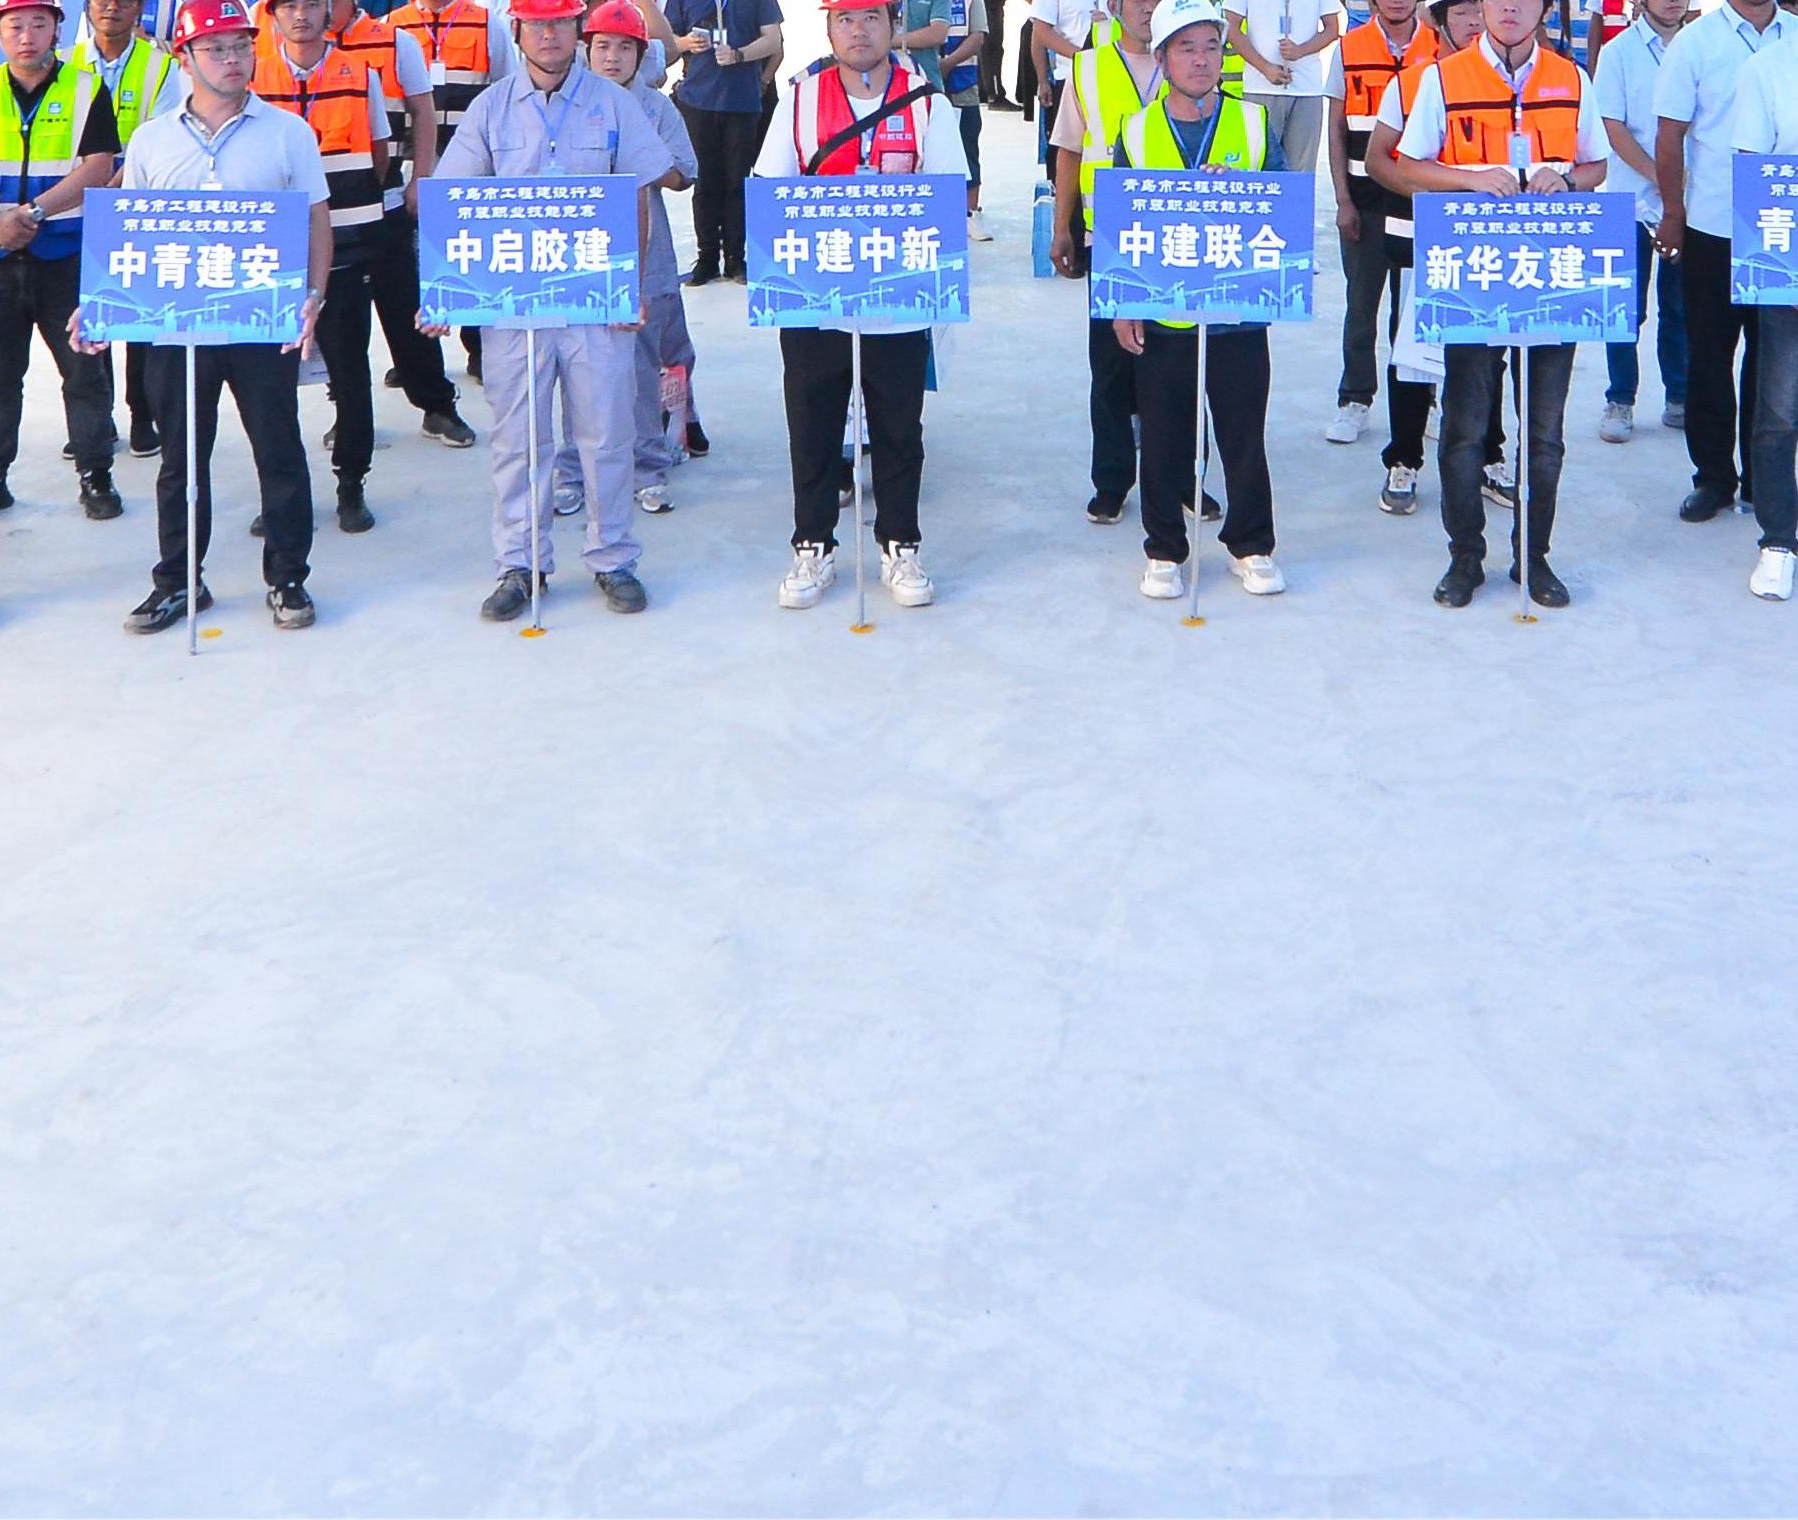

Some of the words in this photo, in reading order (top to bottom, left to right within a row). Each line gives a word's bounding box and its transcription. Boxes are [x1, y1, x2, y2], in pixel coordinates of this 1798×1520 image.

[448, 186, 604, 201] 青岛市工程建设行业
[775, 185, 932, 199] 青岛市工程建设行业
[1122, 179, 1282, 195] 青岛市工程建设行业
[114, 199, 275, 215] 青岛市工程建设行业
[1443, 201, 1601, 216] 青岛市工程建设行业
[447, 228, 611, 273] 中启胶建
[774, 227, 941, 274] 中建中新
[1119, 223, 1287, 269] 中建联合
[109, 246, 280, 289] 中青建安
[1426, 245, 1624, 290] 新华友建工
